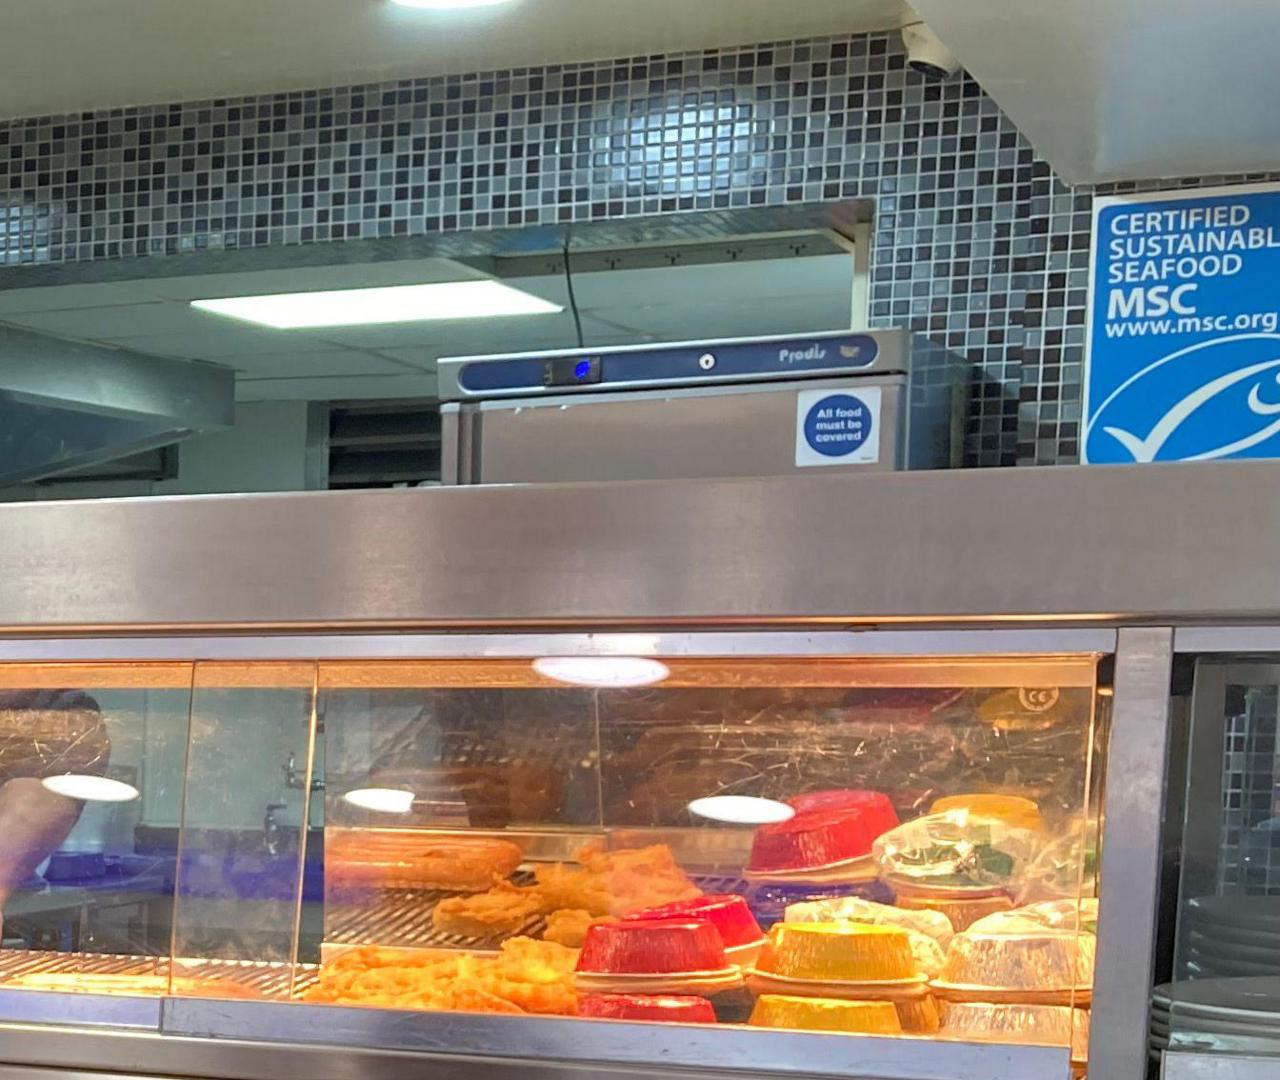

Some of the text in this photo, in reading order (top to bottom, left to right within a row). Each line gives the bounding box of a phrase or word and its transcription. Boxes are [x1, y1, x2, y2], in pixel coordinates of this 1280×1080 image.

[1111, 205, 1250, 235] CERTIFIED
[1109, 227, 1280, 260] SUSTAINABL
[1108, 254, 1242, 284] SEAFOOD
[1107, 283, 1197, 319] MSC
[1105, 312, 1277, 338] www.msc.org
[816, 407, 862, 418] All food
[816, 419, 862, 430] must be
[815, 431, 862, 443] covered
